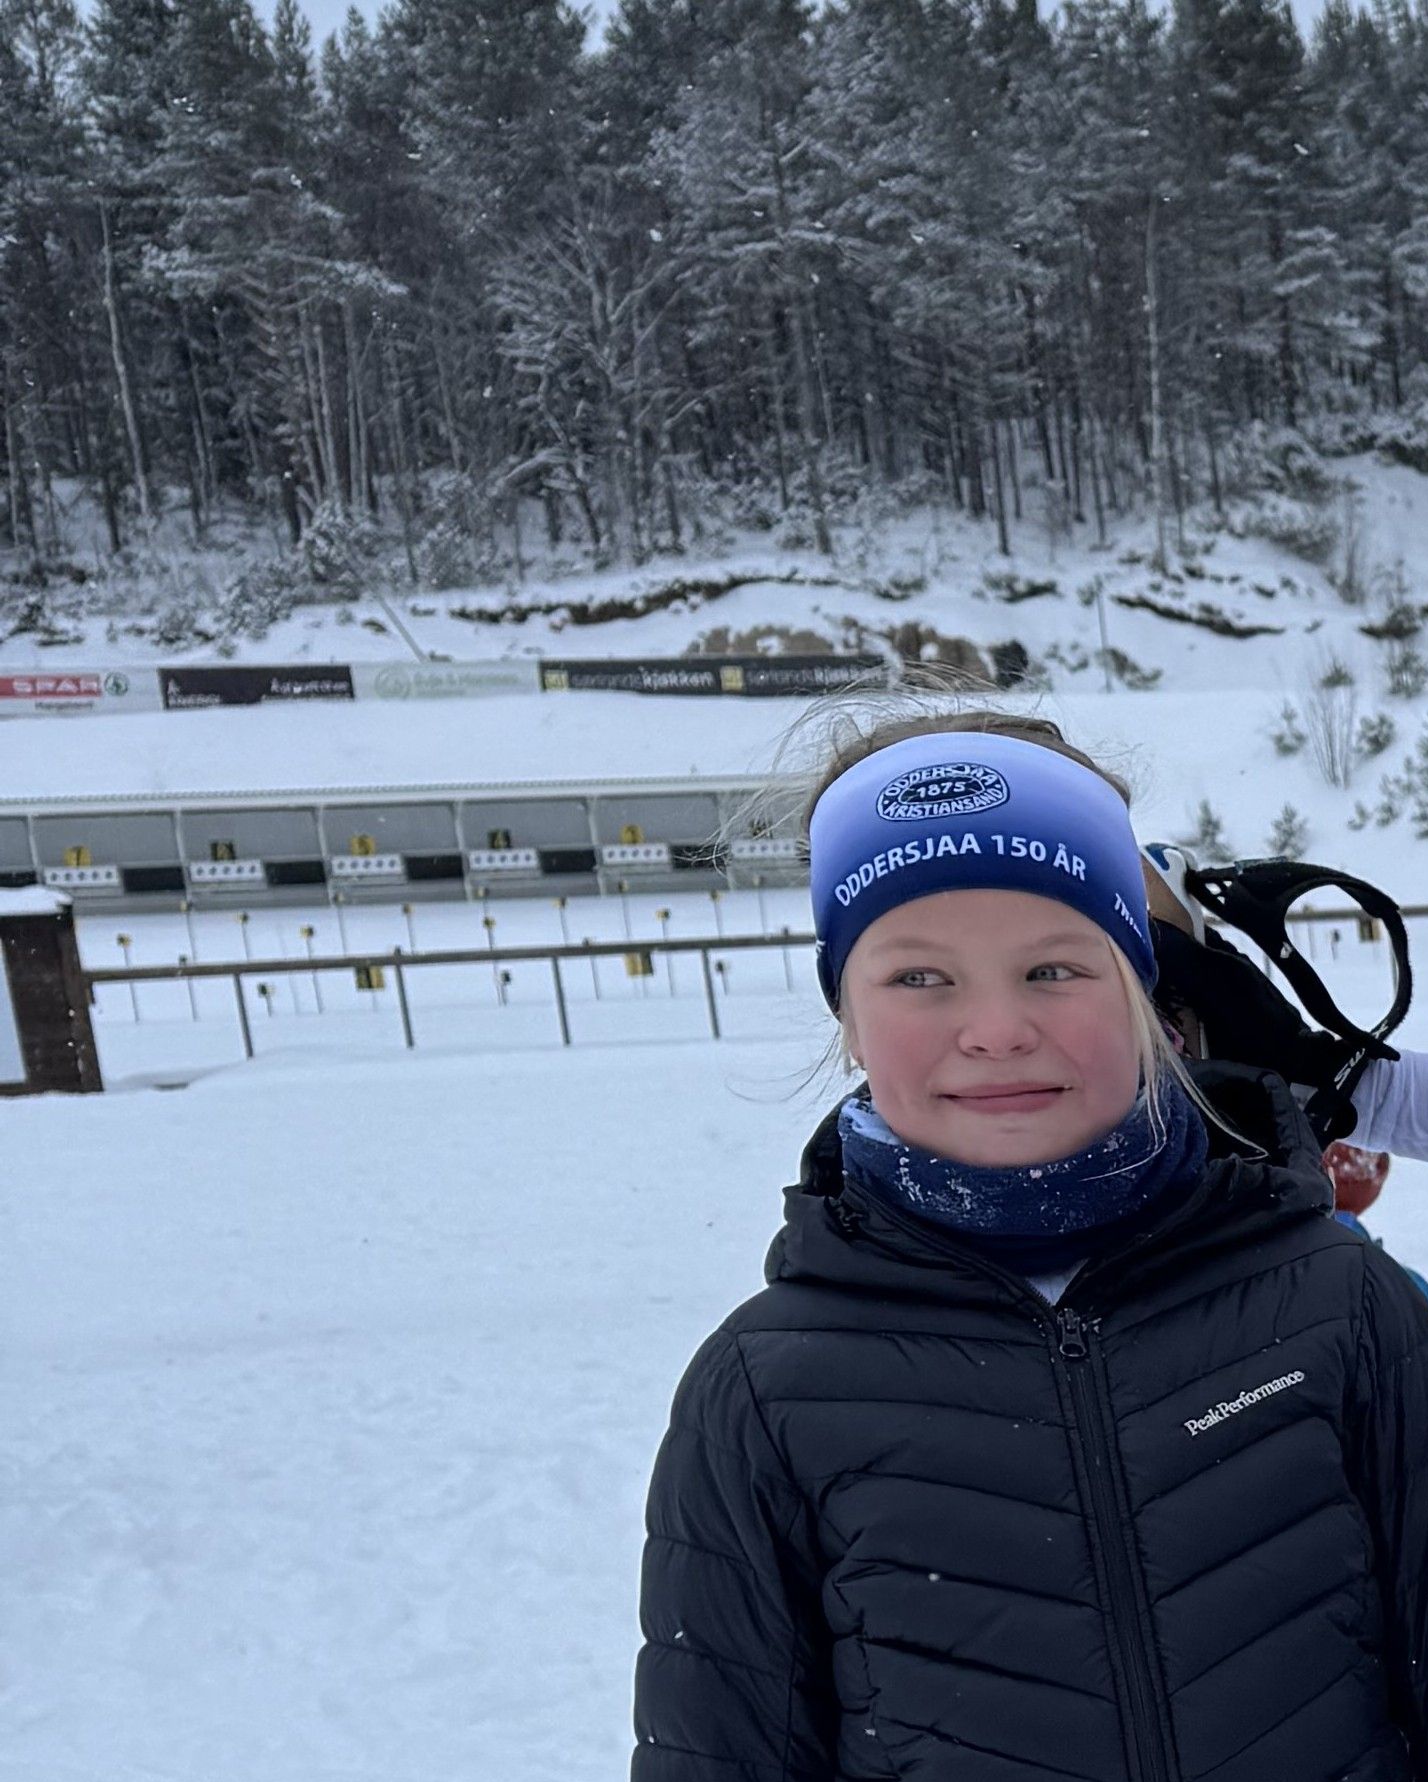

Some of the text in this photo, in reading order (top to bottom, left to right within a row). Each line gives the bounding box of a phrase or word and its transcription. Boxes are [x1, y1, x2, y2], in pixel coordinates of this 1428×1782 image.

[884, 763, 998, 797] ODDERSJAA
[916, 781, 967, 799] 1875
[884, 786, 1004, 818] KRISTIANSAND
[834, 832, 1087, 907] ODDERSJAA 150 ÅR
